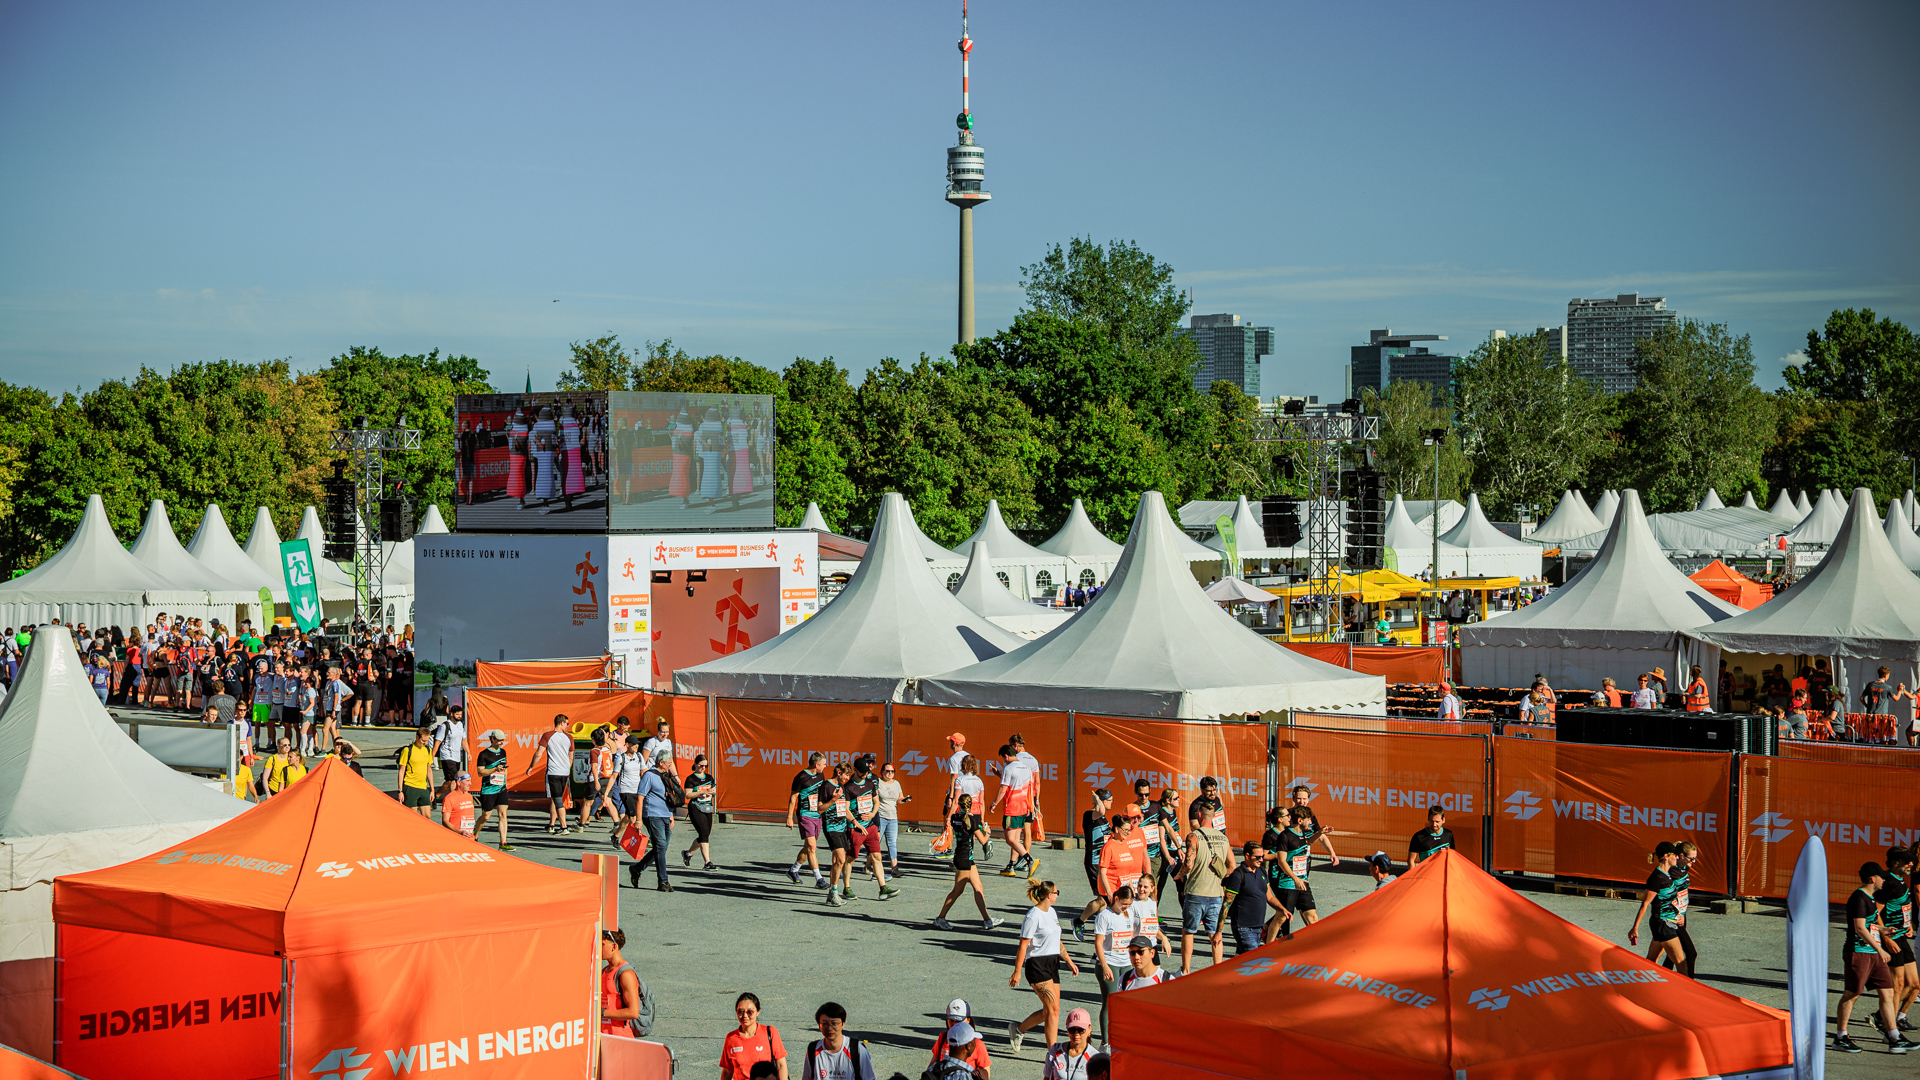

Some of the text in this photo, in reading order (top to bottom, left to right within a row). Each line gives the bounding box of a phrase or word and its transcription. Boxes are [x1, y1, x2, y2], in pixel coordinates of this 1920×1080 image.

[480, 460, 510, 478] ENERGIE
[638, 459, 673, 477] ENERGIE
[423, 549, 520, 559] DIE ENERGIE VON WIEN
[760, 748, 803, 766] WIEN
[1122, 768, 1258, 797] WIEN ENRGIE
[1327, 784, 1474, 813] WIEN ENERGIE
[1551, 798, 1717, 833] WIEN ENERGIE
[1803, 820, 1871, 846] WIEN
[187, 852, 294, 876] WIEN ENERGIE
[357, 851, 496, 871] WIEN ENERGIE
[1280, 963, 1437, 1010] WIEN ENERGIE
[1511, 969, 1669, 998] WIEN ENERGIE
[384, 1018, 585, 1077] WIEN ENERGIE
